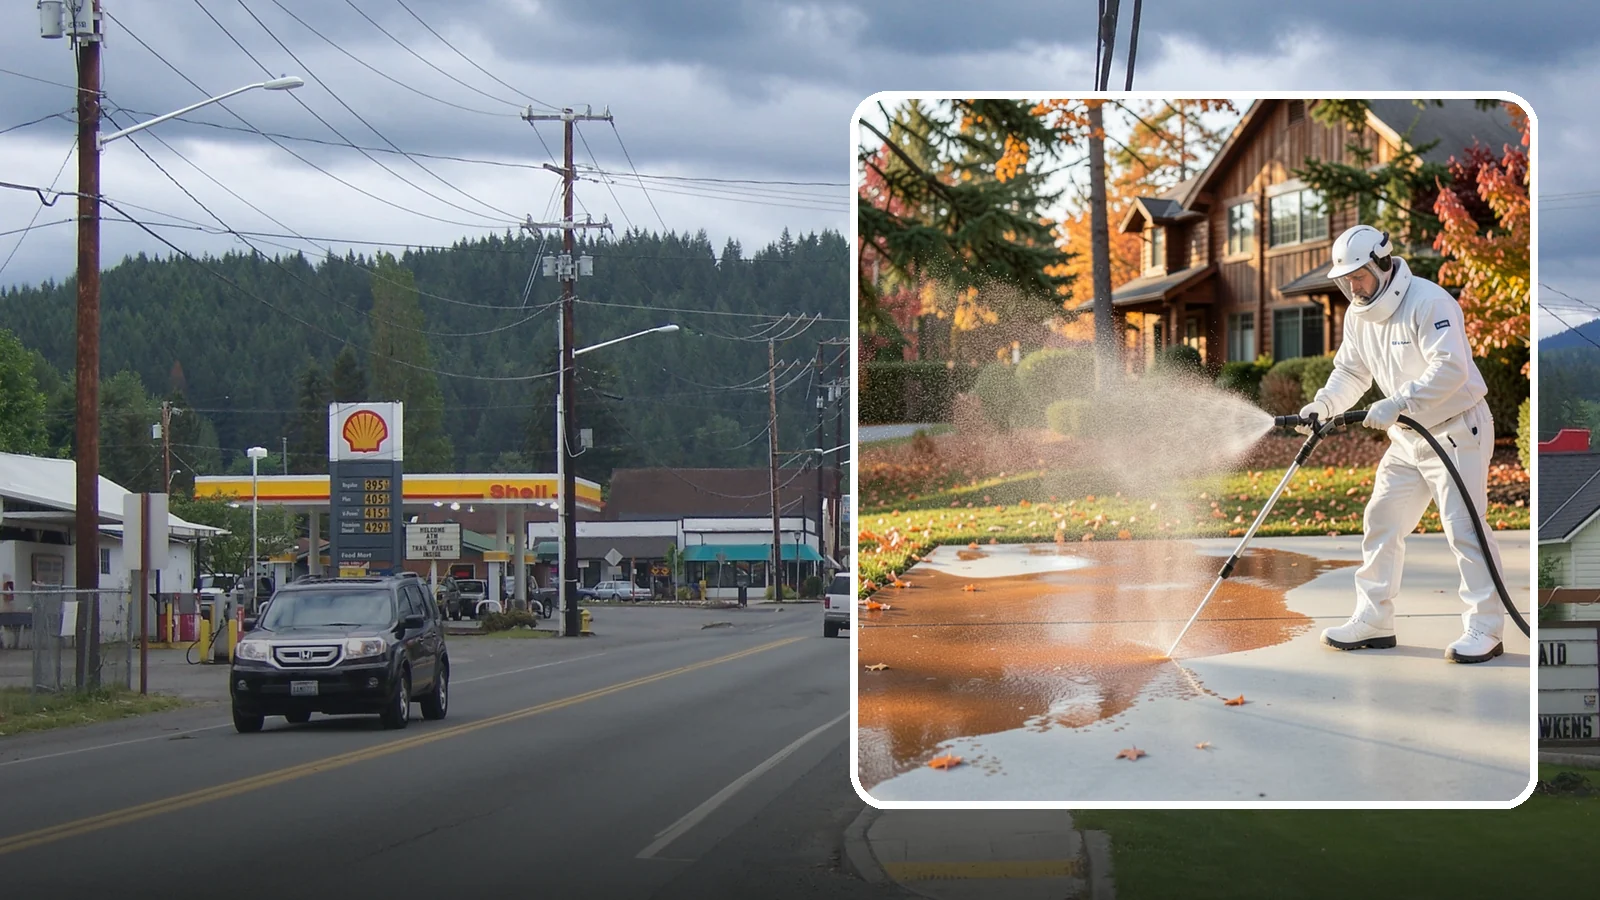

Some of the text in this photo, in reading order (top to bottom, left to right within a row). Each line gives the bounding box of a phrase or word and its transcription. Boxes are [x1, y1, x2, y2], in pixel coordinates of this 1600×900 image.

[366, 480, 383, 490] 395
[490, 484, 547, 499] Shell
[365, 494, 383, 504] 405
[365, 508, 383, 518] 415
[365, 522, 383, 532] 429
